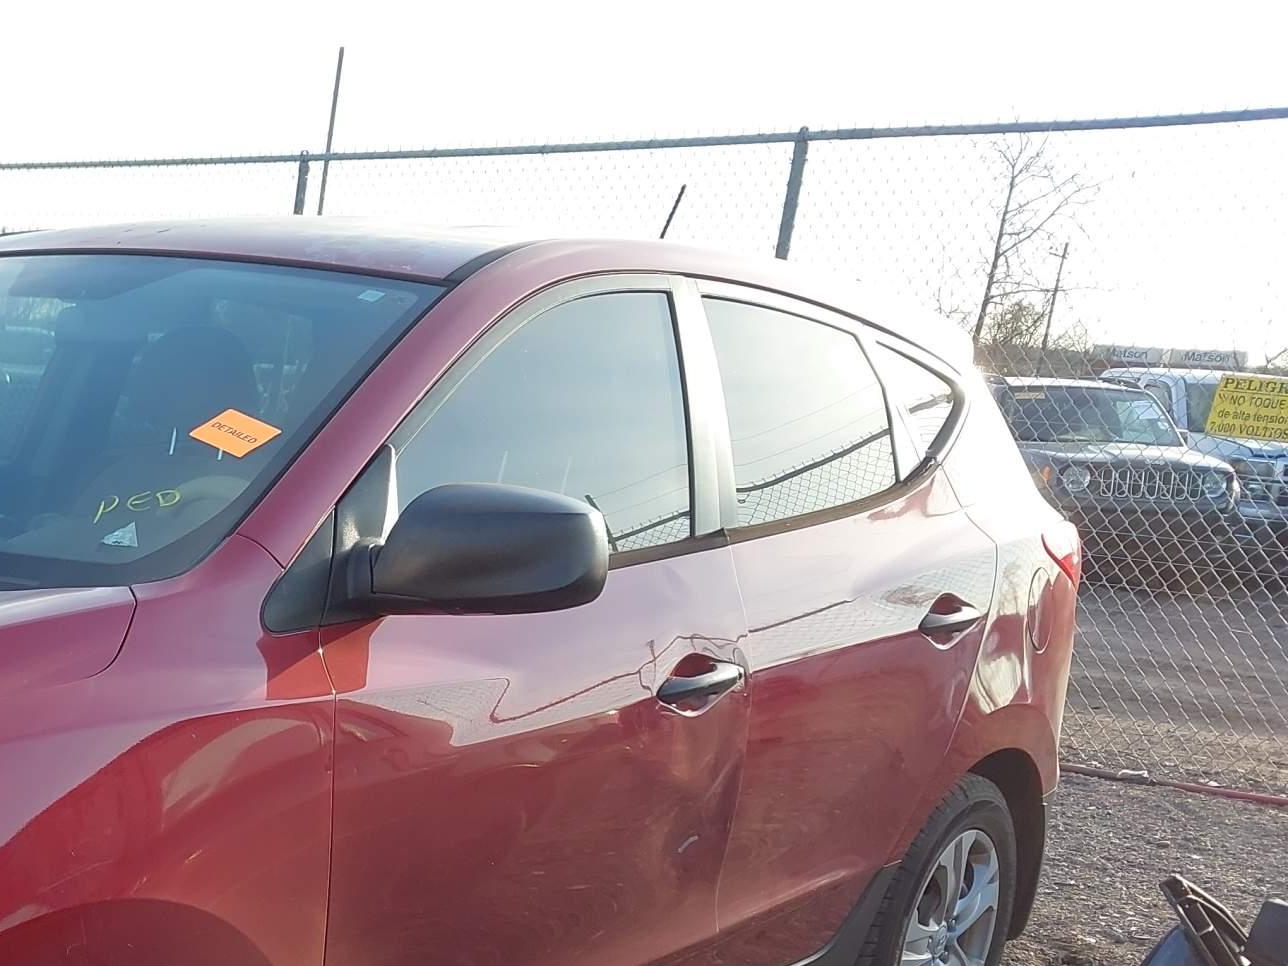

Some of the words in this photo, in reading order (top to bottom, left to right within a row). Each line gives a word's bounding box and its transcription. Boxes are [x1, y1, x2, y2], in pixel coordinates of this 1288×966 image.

[1183, 351, 1230, 363] Matson
[1230, 395, 1246, 406] NO
[1249, 397, 1287, 410] TOQUE
[1218, 409, 1230, 418] de
[1232, 410, 1250, 421] alta
[211, 421, 257, 444] DETAILED
[1239, 424, 1288, 440] VOLTIOS
[93, 490, 182, 524] PED
